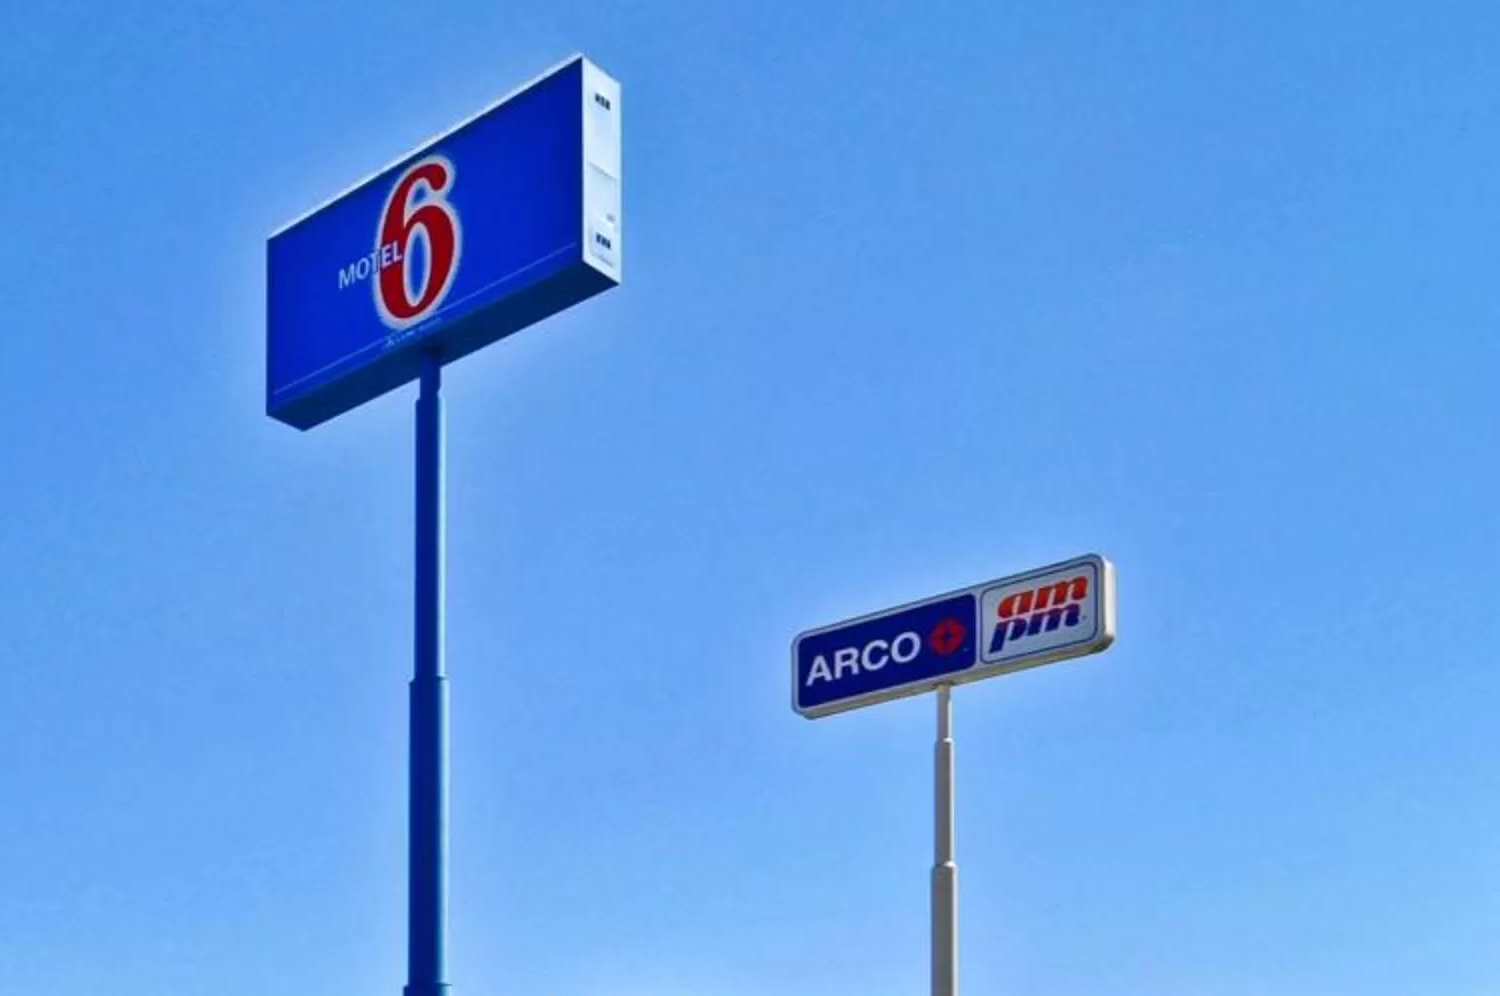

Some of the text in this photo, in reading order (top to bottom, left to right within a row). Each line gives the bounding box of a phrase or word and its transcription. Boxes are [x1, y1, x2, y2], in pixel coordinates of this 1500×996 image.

[338, 157, 460, 327] MOTEL 6
[997, 576, 1088, 618] am
[989, 603, 1081, 653] pm
[806, 631, 920, 686] ARCO
